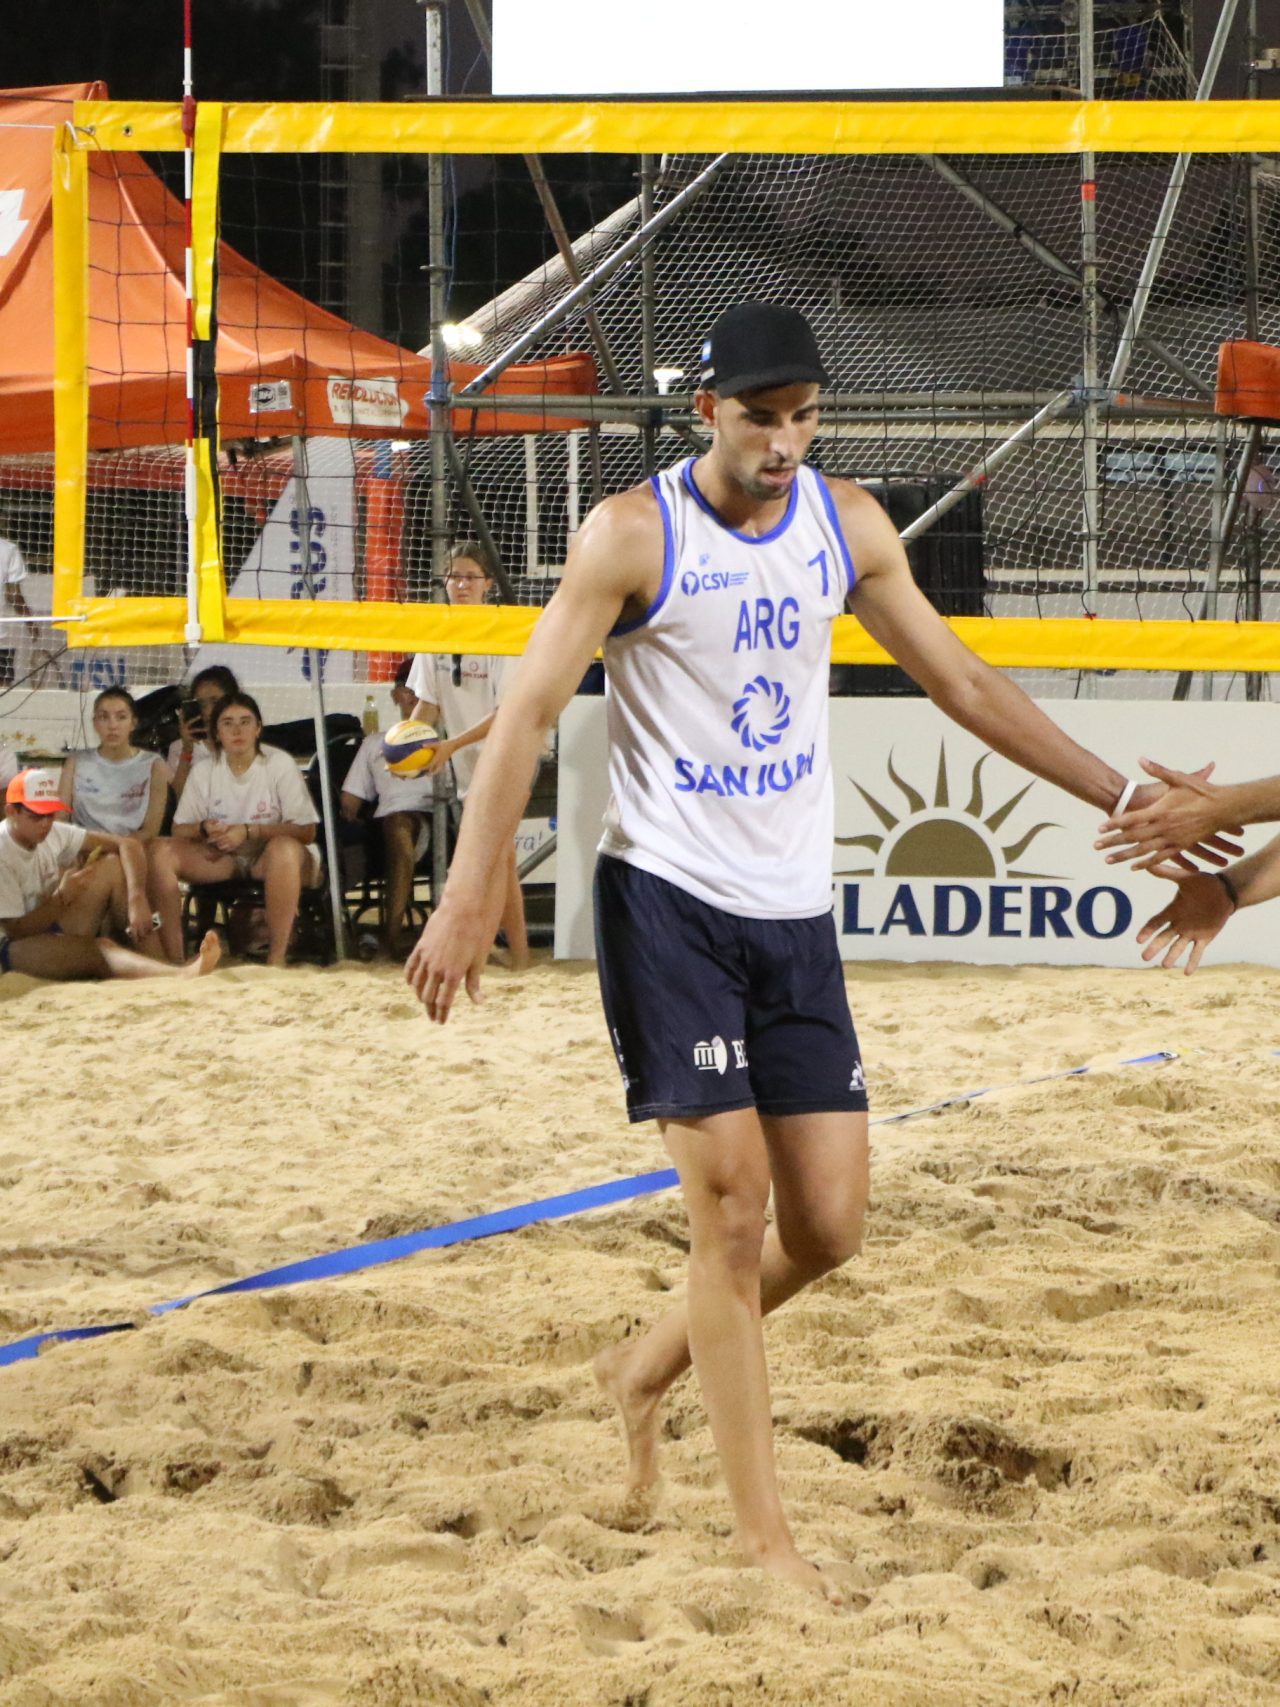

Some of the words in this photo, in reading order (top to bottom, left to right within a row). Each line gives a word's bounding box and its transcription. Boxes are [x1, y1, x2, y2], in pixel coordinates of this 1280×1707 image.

[701, 571, 730, 591] CSV
[807, 550, 829, 597] 1
[733, 597, 800, 653] ARG
[674, 757, 750, 797] SAN
[832, 883, 1134, 940] LADERO
